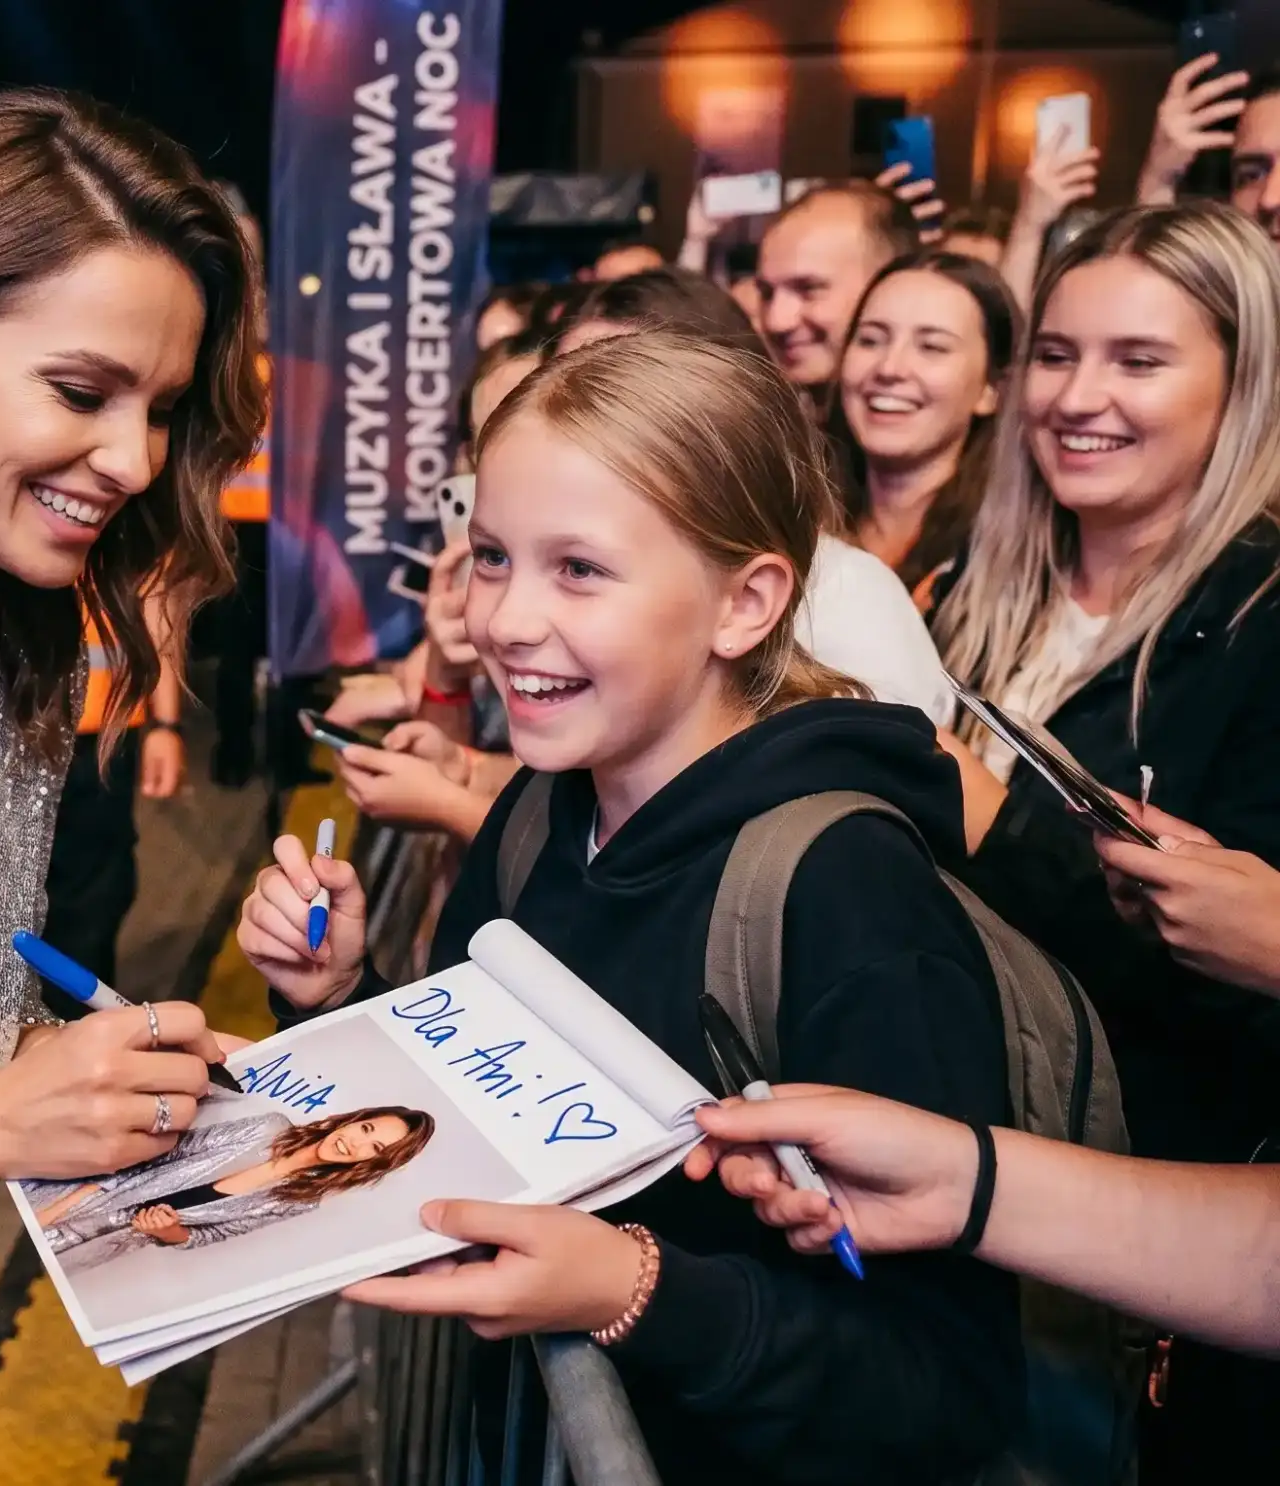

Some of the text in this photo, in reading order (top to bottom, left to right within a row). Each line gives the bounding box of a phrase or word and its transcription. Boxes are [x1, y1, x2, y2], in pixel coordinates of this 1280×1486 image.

[346, 73, 399, 281] SŁAWA
[404, 10, 461, 522] KONCERTOWA NOC
[346, 293, 392, 310] I
[344, 321, 392, 554] MUZYKA
[391, 987, 466, 1049] Dla
